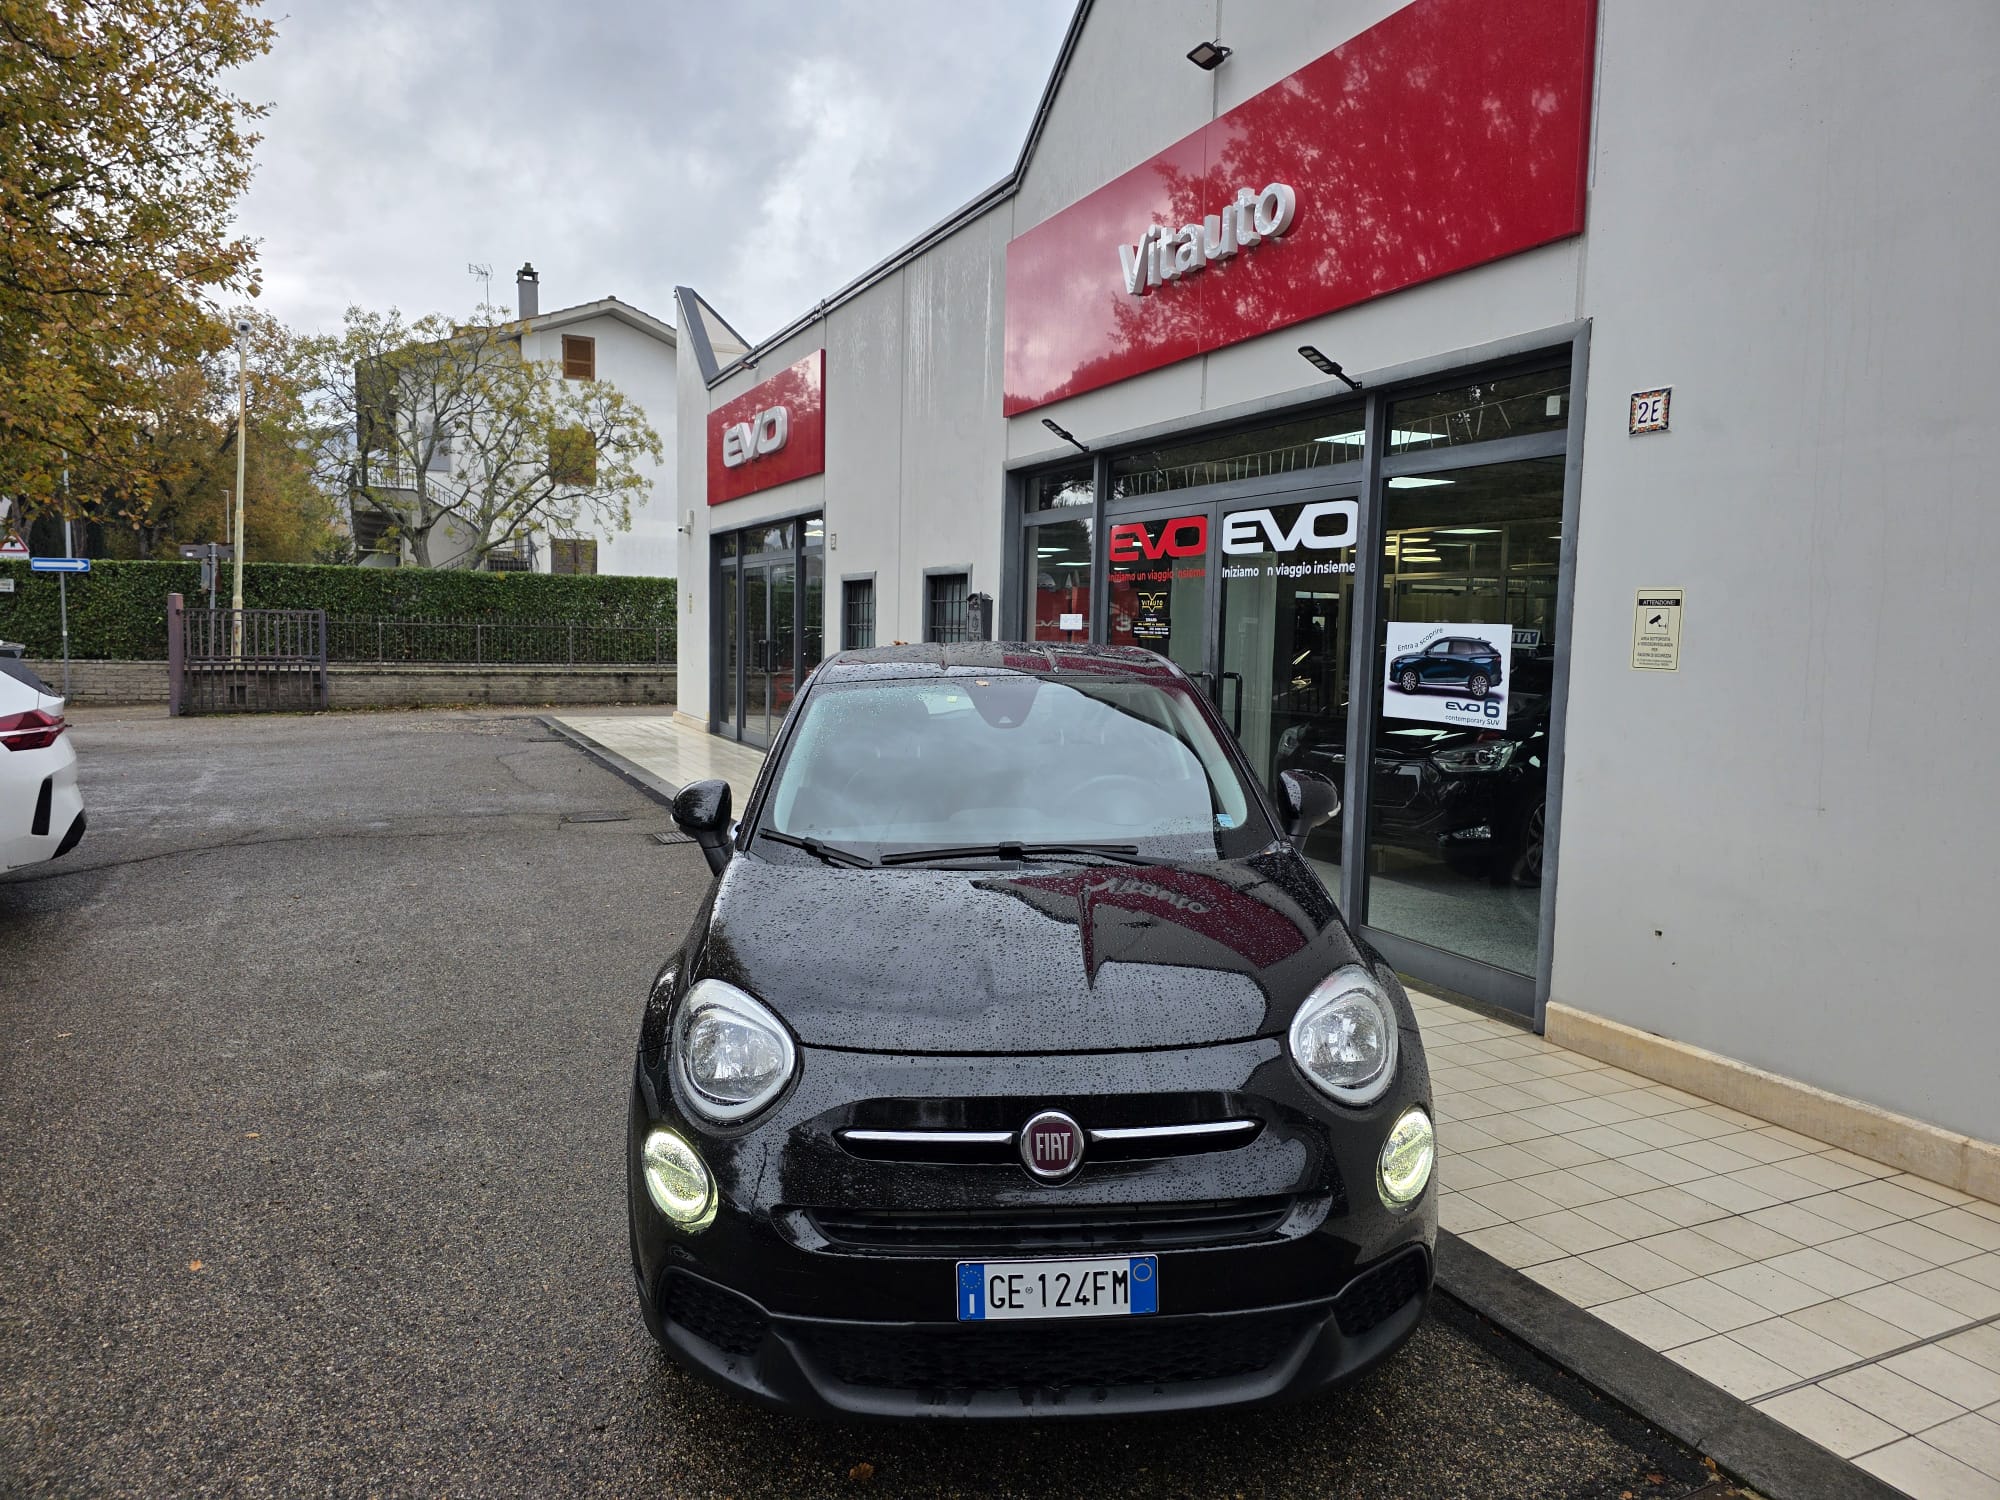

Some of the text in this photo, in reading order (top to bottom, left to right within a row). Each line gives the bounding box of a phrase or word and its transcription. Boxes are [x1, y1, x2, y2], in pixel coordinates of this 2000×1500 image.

[1118, 182, 1296, 295] Vitauto
[1637, 399, 1661, 424] 2E
[723, 405, 788, 468] EVO
[1109, 515, 1208, 562] EVO
[1221, 500, 1359, 555] EVO
[1137, 572, 1146, 581] un
[1148, 568, 1174, 582] viaggio
[1222, 565, 1259, 578] Iniziamo
[1275, 561, 1312, 578] viaggio
[1313, 560, 1356, 574] insieme
[1397, 640, 1414, 652] Entra
[1419, 627, 1444, 646] scoprire
[1445, 699, 1500, 719] EVO 6
[1445, 714, 1500, 727] contemporary SUV
[1035, 1132, 1071, 1161] FIAT
[989, 1274, 1024, 1309] GE
[1038, 1269, 1129, 1308] 124FM
